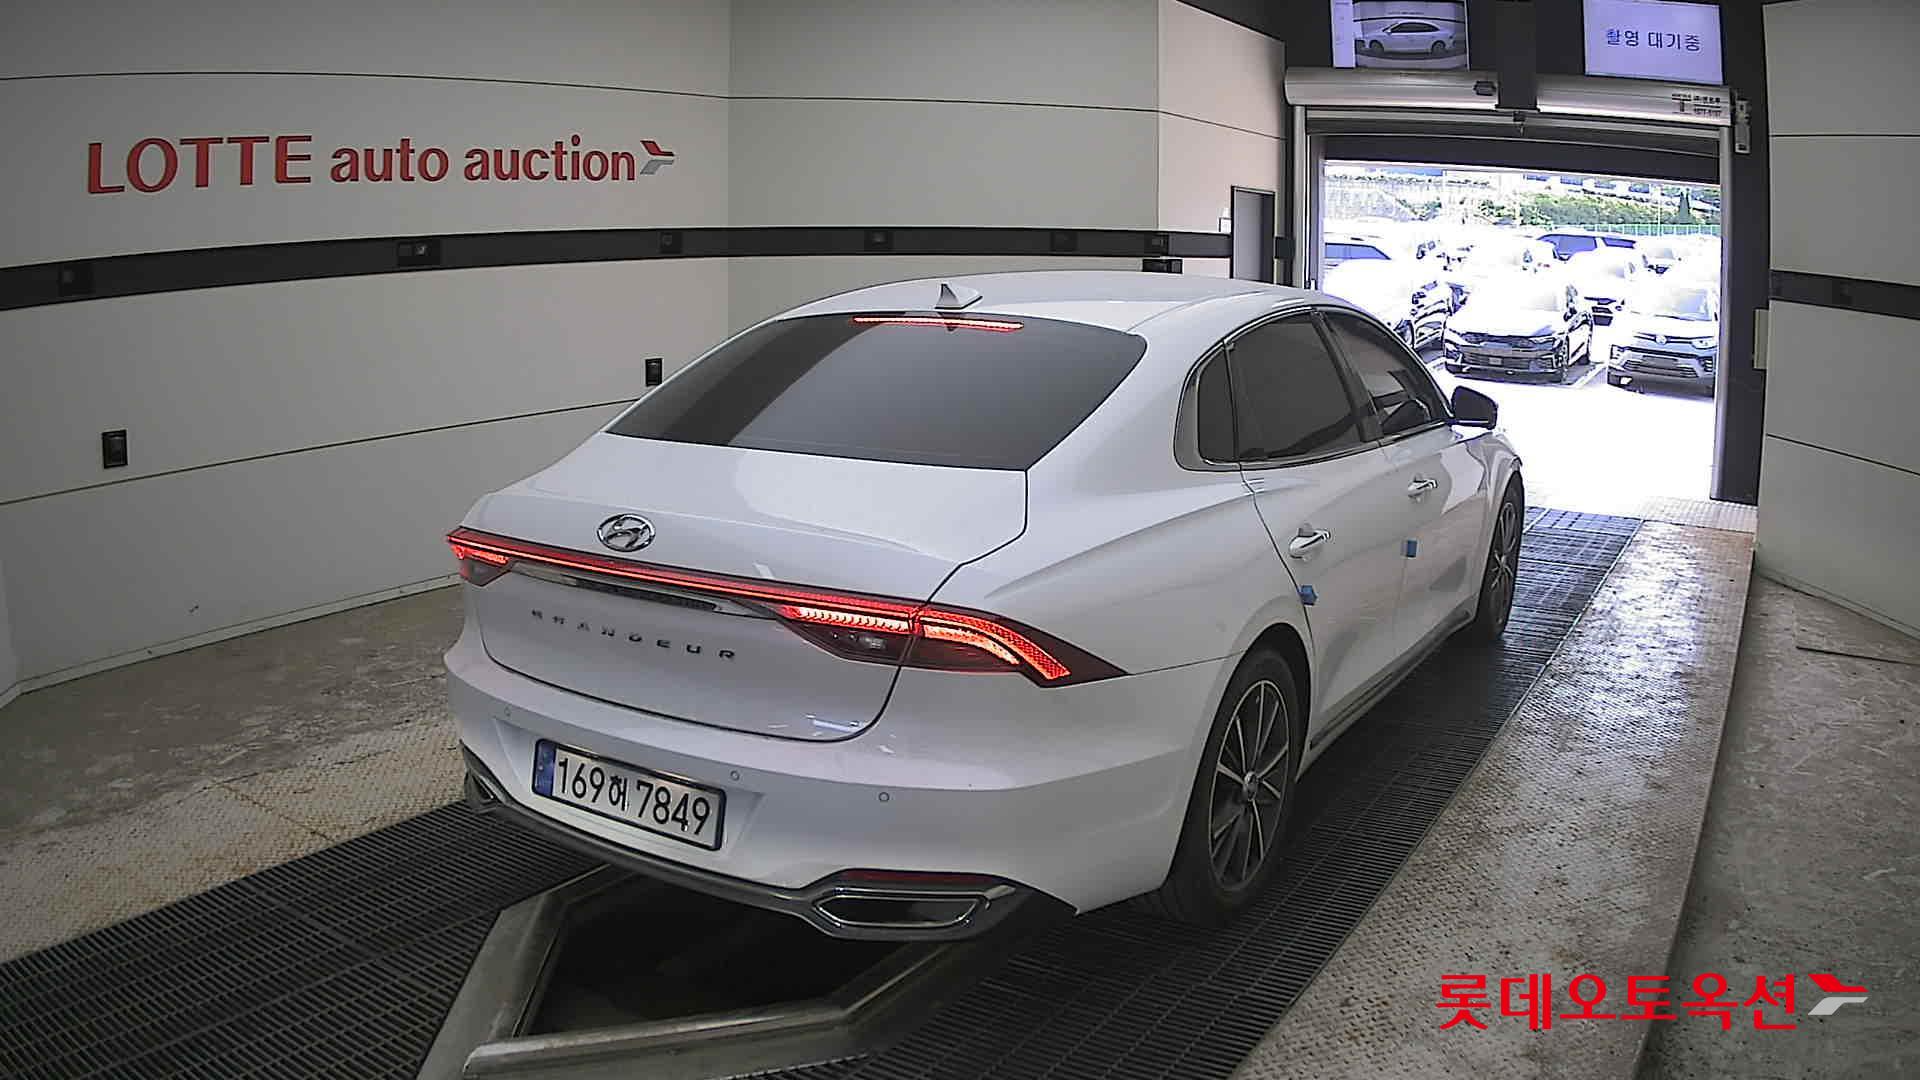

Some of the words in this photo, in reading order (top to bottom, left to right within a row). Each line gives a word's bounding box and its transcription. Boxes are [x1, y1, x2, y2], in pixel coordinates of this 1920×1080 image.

[1607, 28, 1639, 47] 촬영
[1647, 31, 1700, 52] 대기중
[87, 135, 312, 194] LOTTE
[329, 137, 450, 183] auto
[463, 134, 637, 182] auction
[558, 757, 630, 812] 169허
[636, 779, 711, 836] 7849
